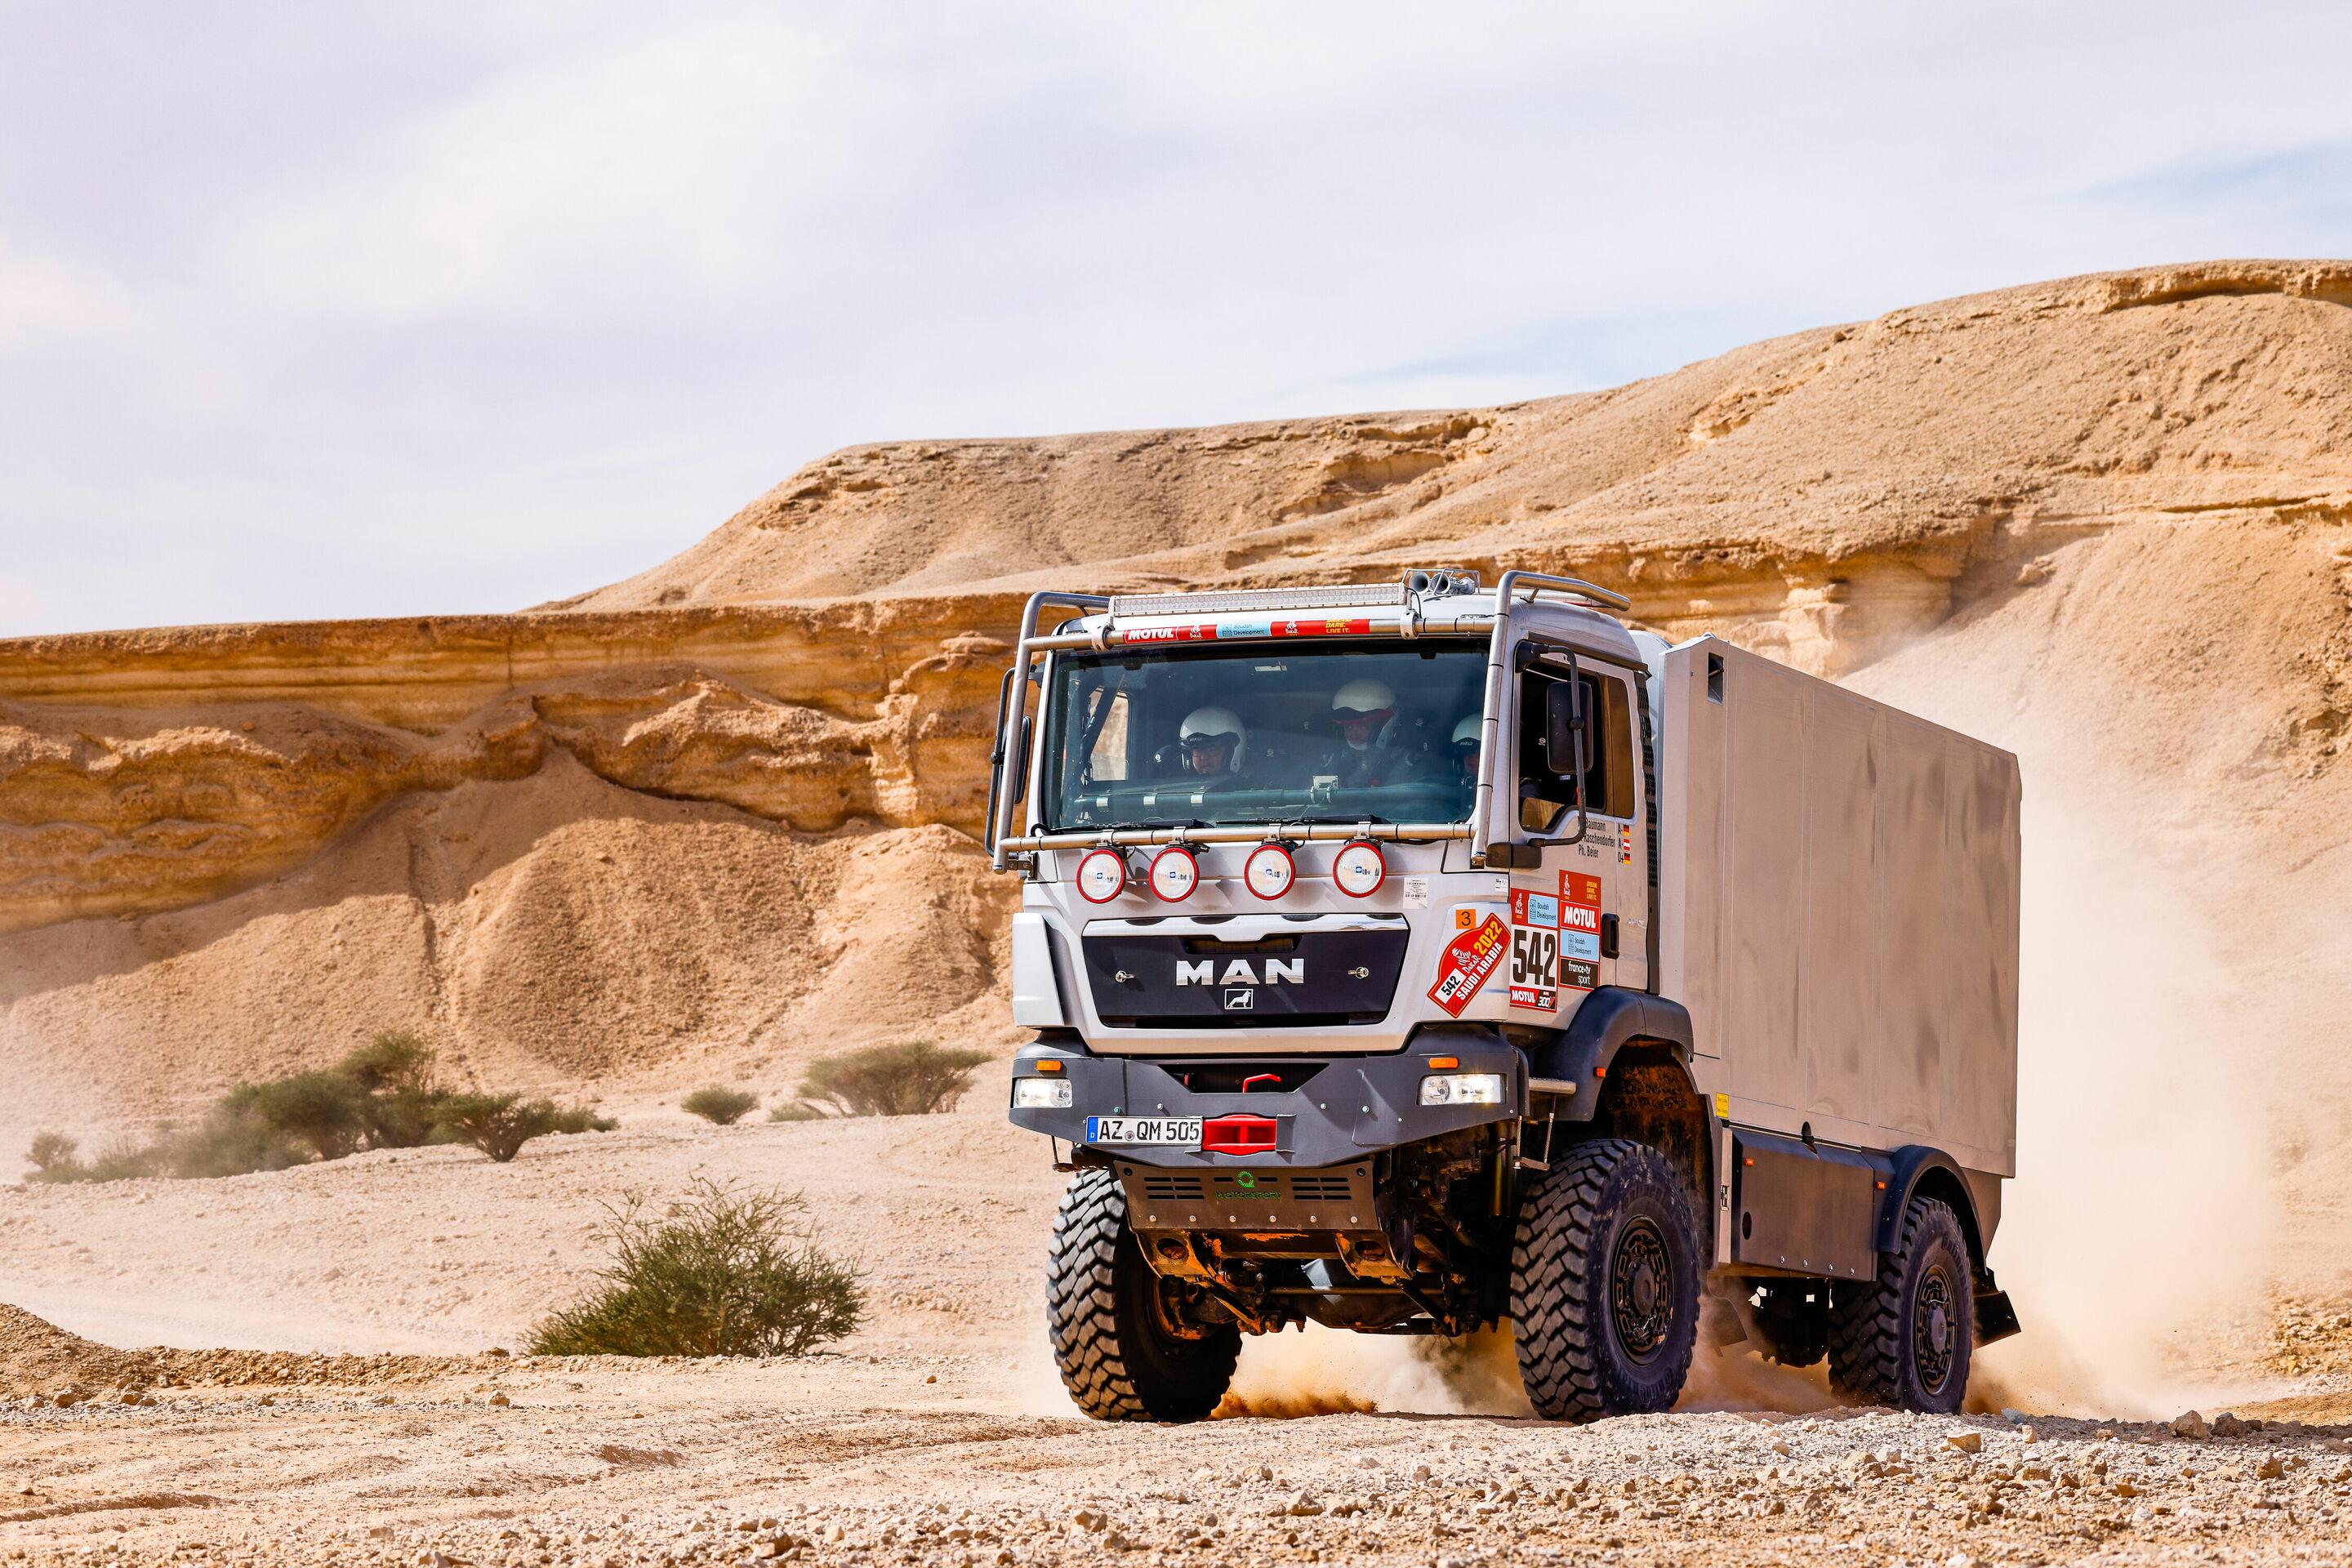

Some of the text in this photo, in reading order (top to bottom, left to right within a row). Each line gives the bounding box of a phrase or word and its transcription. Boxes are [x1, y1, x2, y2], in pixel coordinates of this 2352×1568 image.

[1128, 628, 1174, 640] MOTUL
[1461, 911, 1472, 926] 3
[1564, 906, 1597, 929] MOTUL
[1473, 920, 1503, 956] 2022
[1461, 954, 1482, 974] DAKAR
[1512, 929, 1557, 987] 542
[1176, 958, 1305, 986] MAN
[1455, 942, 1503, 1000] SAUDI ARABIA
[1578, 975, 1591, 987] sport
[1441, 975, 1461, 996] 542
[1512, 989, 1535, 1003] MOTUL
[1099, 1120, 1200, 1141] AZ QM 505
[1215, 1192, 1281, 1200] MOTORSPORT
